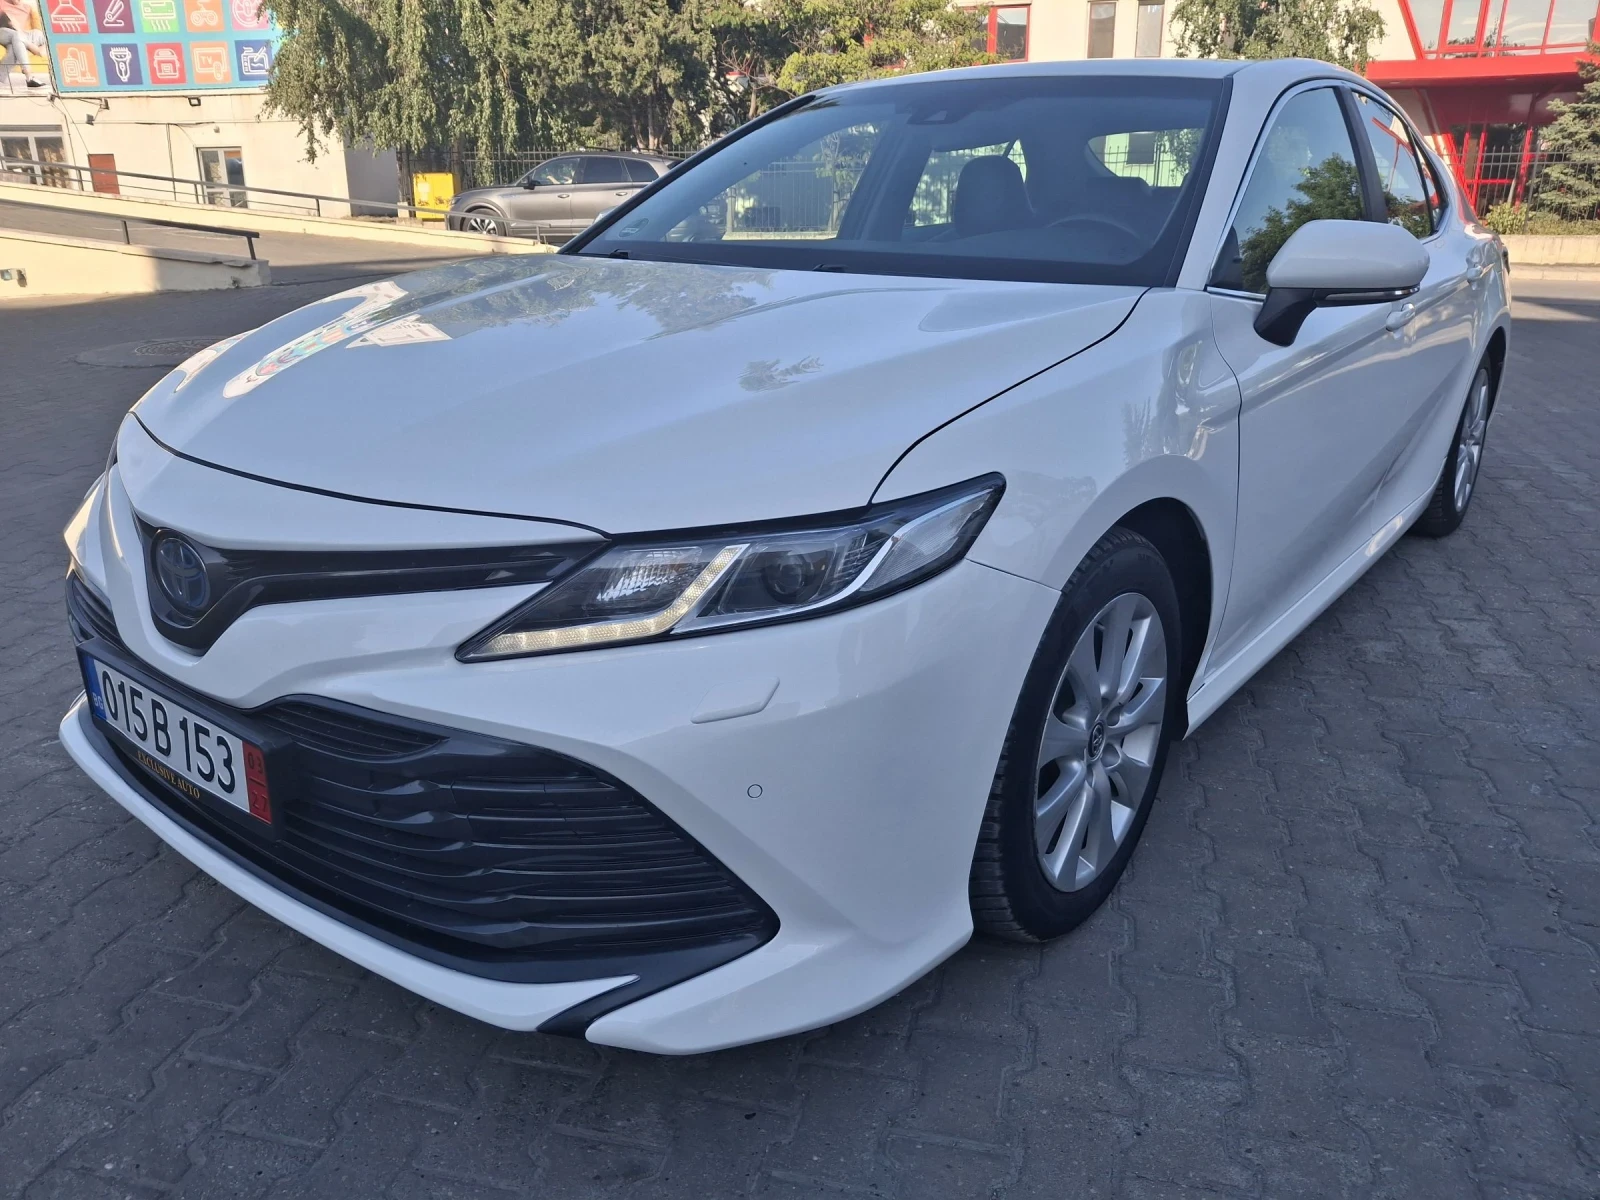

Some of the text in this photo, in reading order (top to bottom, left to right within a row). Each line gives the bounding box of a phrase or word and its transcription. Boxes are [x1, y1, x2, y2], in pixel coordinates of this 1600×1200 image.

[200, 55, 213, 65] TV
[92, 691, 104, 710] BG
[247, 751, 264, 775] 03
[137, 750, 200, 799] EXCLUSIVE AUTO
[252, 790, 268, 812] 27
